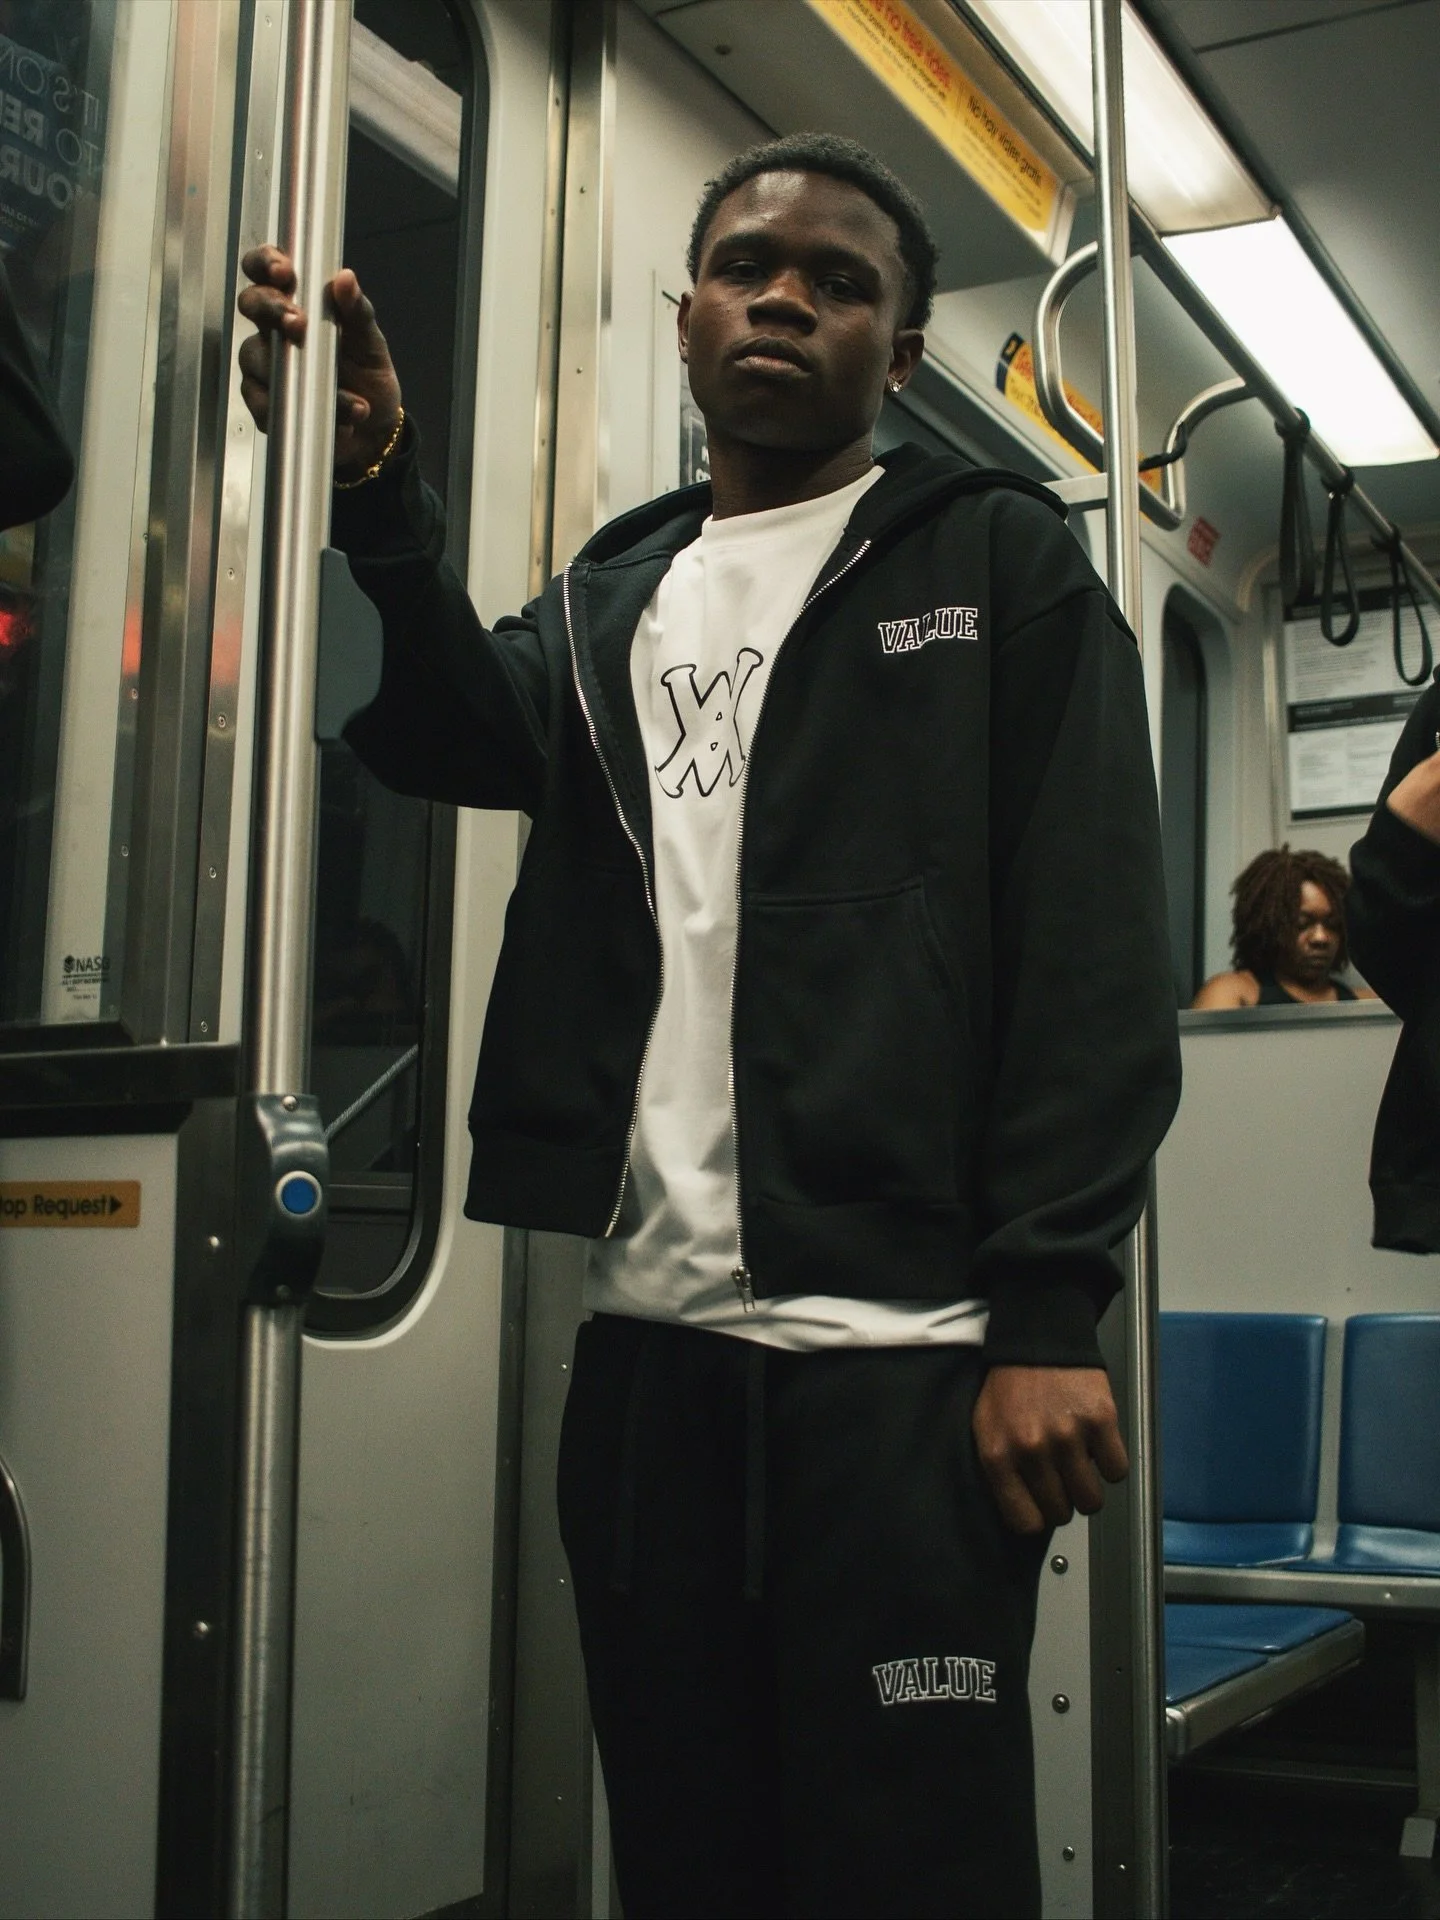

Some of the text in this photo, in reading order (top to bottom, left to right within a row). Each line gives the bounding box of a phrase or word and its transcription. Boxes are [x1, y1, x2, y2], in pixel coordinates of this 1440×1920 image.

[878, 606, 978, 654] VALUE
[34, 1193, 107, 1220] Request
[872, 1656, 997, 1705] VALUE
